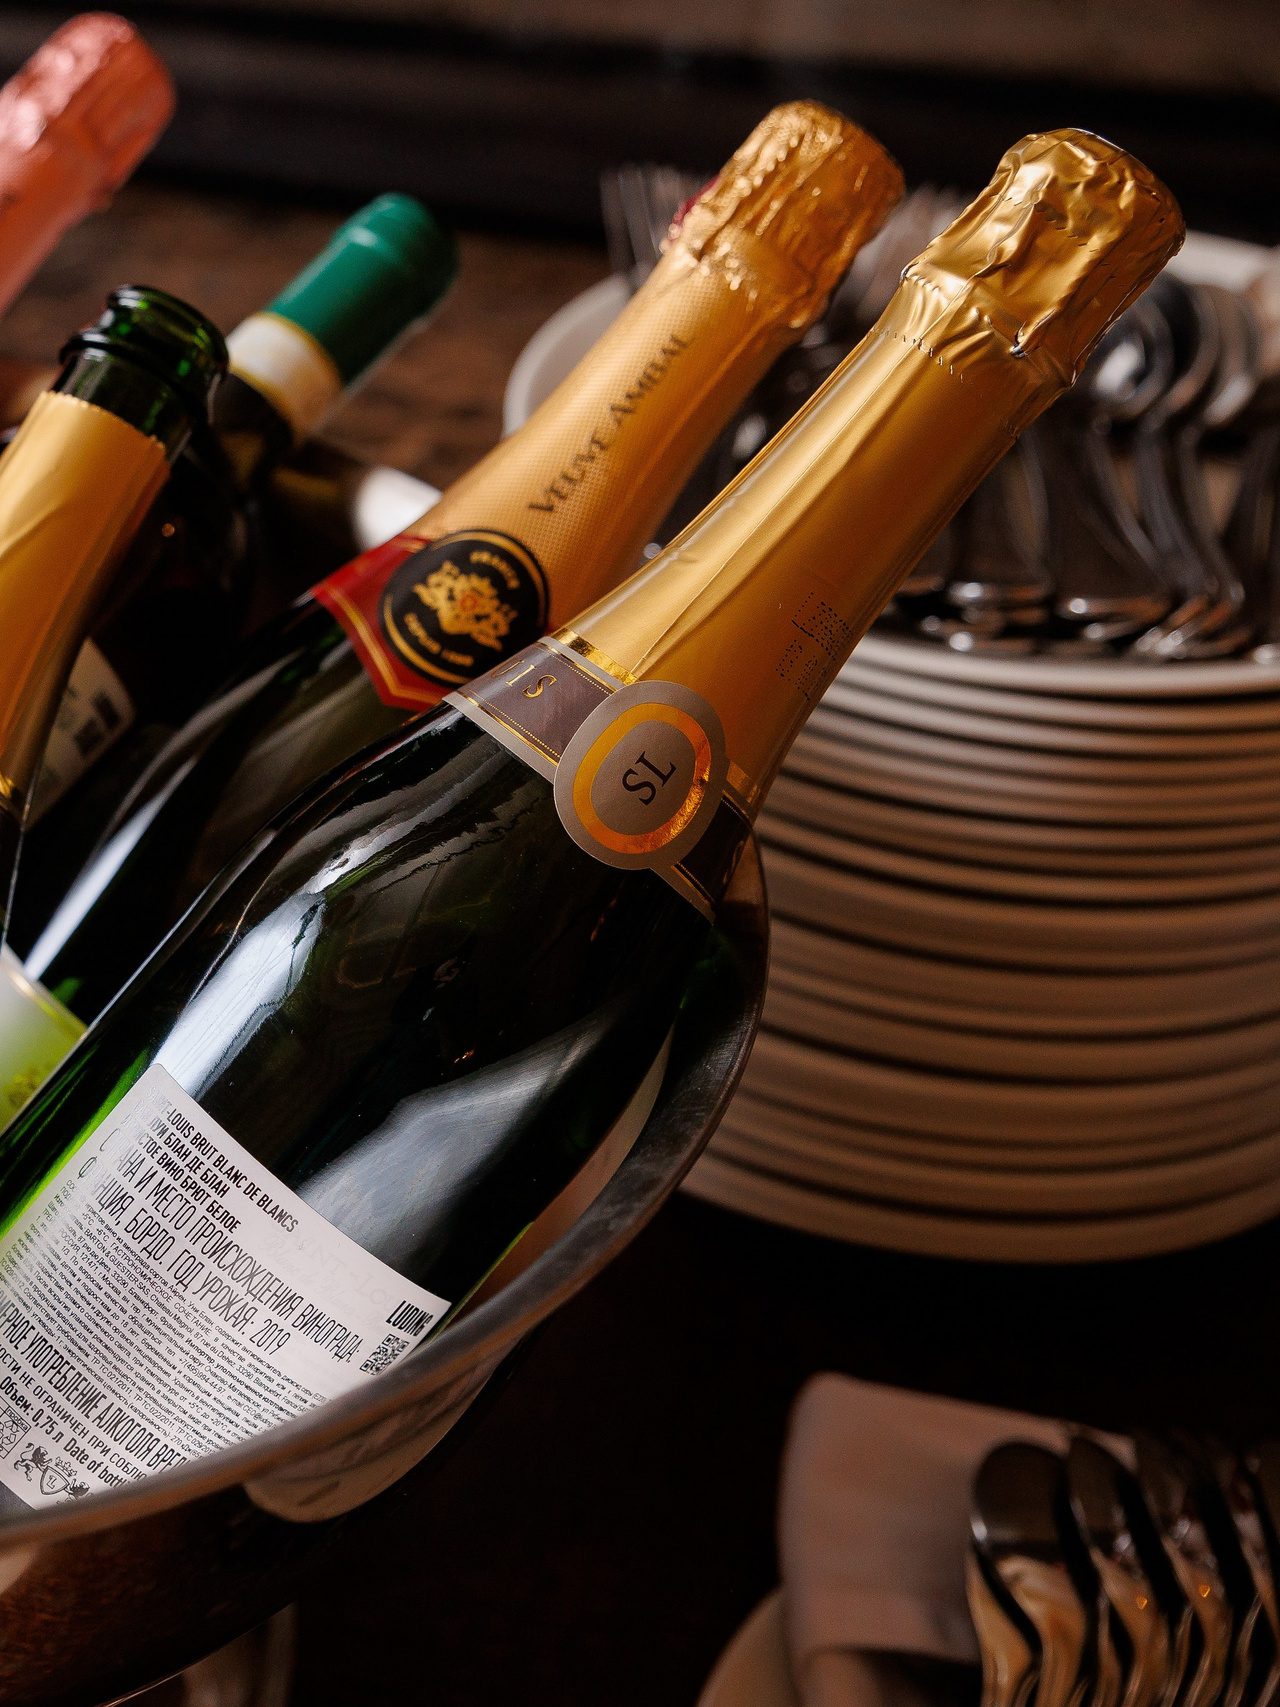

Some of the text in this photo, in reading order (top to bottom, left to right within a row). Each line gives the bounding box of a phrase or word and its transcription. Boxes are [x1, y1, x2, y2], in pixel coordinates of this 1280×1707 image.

[527, 335, 696, 511] VEUVE AMBAL
[622, 751, 677, 806] SL
[133, 1165, 158, 1193] И
[156, 1151, 185, 1182] ВИНО
[179, 1174, 211, 1206] БРЮТ
[205, 1199, 241, 1234] БЕЛОЕ
[163, 1131, 192, 1162] БЛАН
[184, 1154, 205, 1176] ДЕ
[199, 1167, 230, 1198] БЛАН
[189, 1131, 218, 1161] BRUT
[212, 1153, 248, 1189] BLANC
[242, 1181, 261, 1201] DE
[255, 1193, 299, 1233] BLANCS
[145, 1176, 198, 1231] МЕСТО
[83, 1228, 107, 1253] BARTON
[108, 1254, 138, 1284] GUESTIER
[149, 1293, 174, 1317] Chateau
[104, 1223, 117, 1237] вино
[121, 1242, 150, 1270] винограда
[147, 1268, 168, 1288] сортов
[110, 1241, 173, 1302] ГАСТРОНОМИЧЕСКОЕ
[120, 1207, 179, 1268] БОРДО.
[163, 1248, 205, 1292] ГОД
[191, 1270, 262, 1335] УРОЖАЯ:
[249, 1317, 291, 1357] 2019
[181, 1214, 304, 1324] ПРОИСХОЖДЕНИЯ
[62, 1290, 85, 1314] прямого
[83, 1311, 114, 1341] солнечного
[77, 1265, 103, 1292] вопросам
[103, 1290, 127, 1314] качества
[385, 1300, 434, 1337] LUDING
[46, 1287, 70, 1313] вскрытия
[92, 1333, 134, 1372] рекомендуется
[79, 1281, 112, 1313] подросткам
[139, 1337, 178, 1371] беременным
[110, 1324, 134, 1347] органов
[288, 1303, 366, 1367] ВИНОГРАДА:
[6, 1408, 29, 1431] пробка
[18, 1370, 35, 1389] НЕ
[31, 1384, 90, 1439] ОГРАНИЧЕН
[87, 1434, 111, 1456] ПРИ
[19, 1331, 107, 1419] УПОТРЕБЛЕНИЕ
[91, 1399, 161, 1462] АЛКОГОЛЯ
[29, 1407, 58, 1437] 0,75
[52, 1429, 64, 1442] л
[63, 1436, 92, 1465] Date
[85, 1455, 104, 1474] of
[97, 1465, 130, 1488] bott
